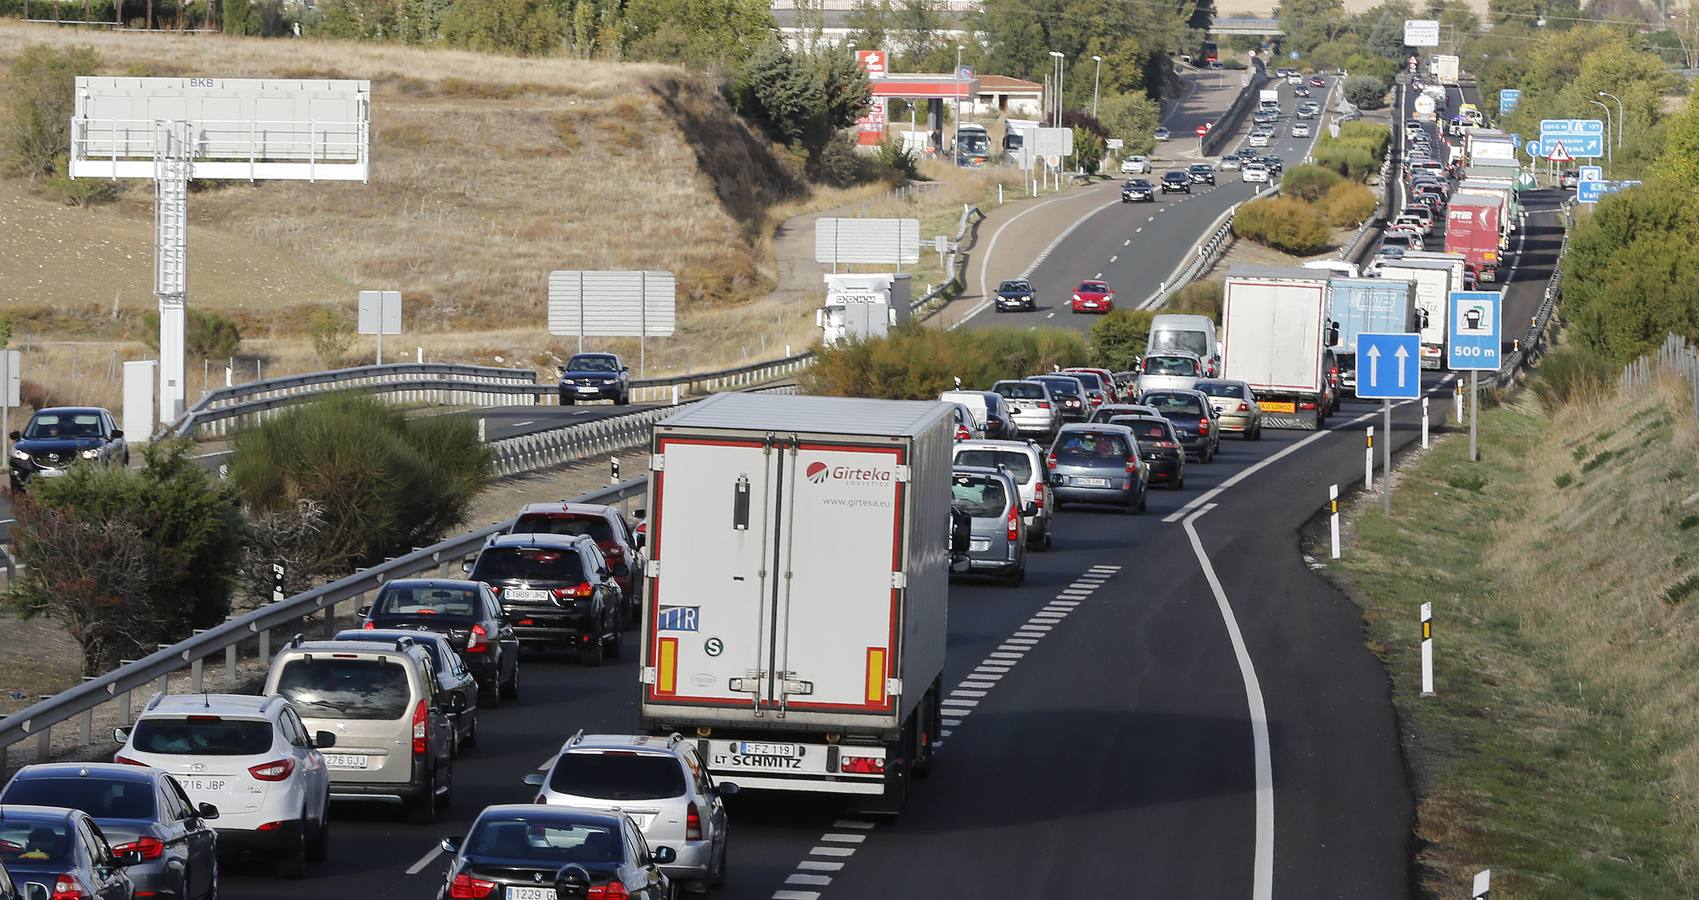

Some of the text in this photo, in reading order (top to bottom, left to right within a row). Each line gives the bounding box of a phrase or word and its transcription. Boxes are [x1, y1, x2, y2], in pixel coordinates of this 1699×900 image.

[190, 78, 214, 88] BKB
[1455, 346, 1495, 358] 500 m
[833, 466, 891, 481] Girteka
[660, 607, 696, 630] TIR
[325, 755, 344, 765] 276
[715, 755, 802, 769] LT SCHMITZ
[206, 781, 226, 790] JBP
[515, 889, 541, 900] 1229
